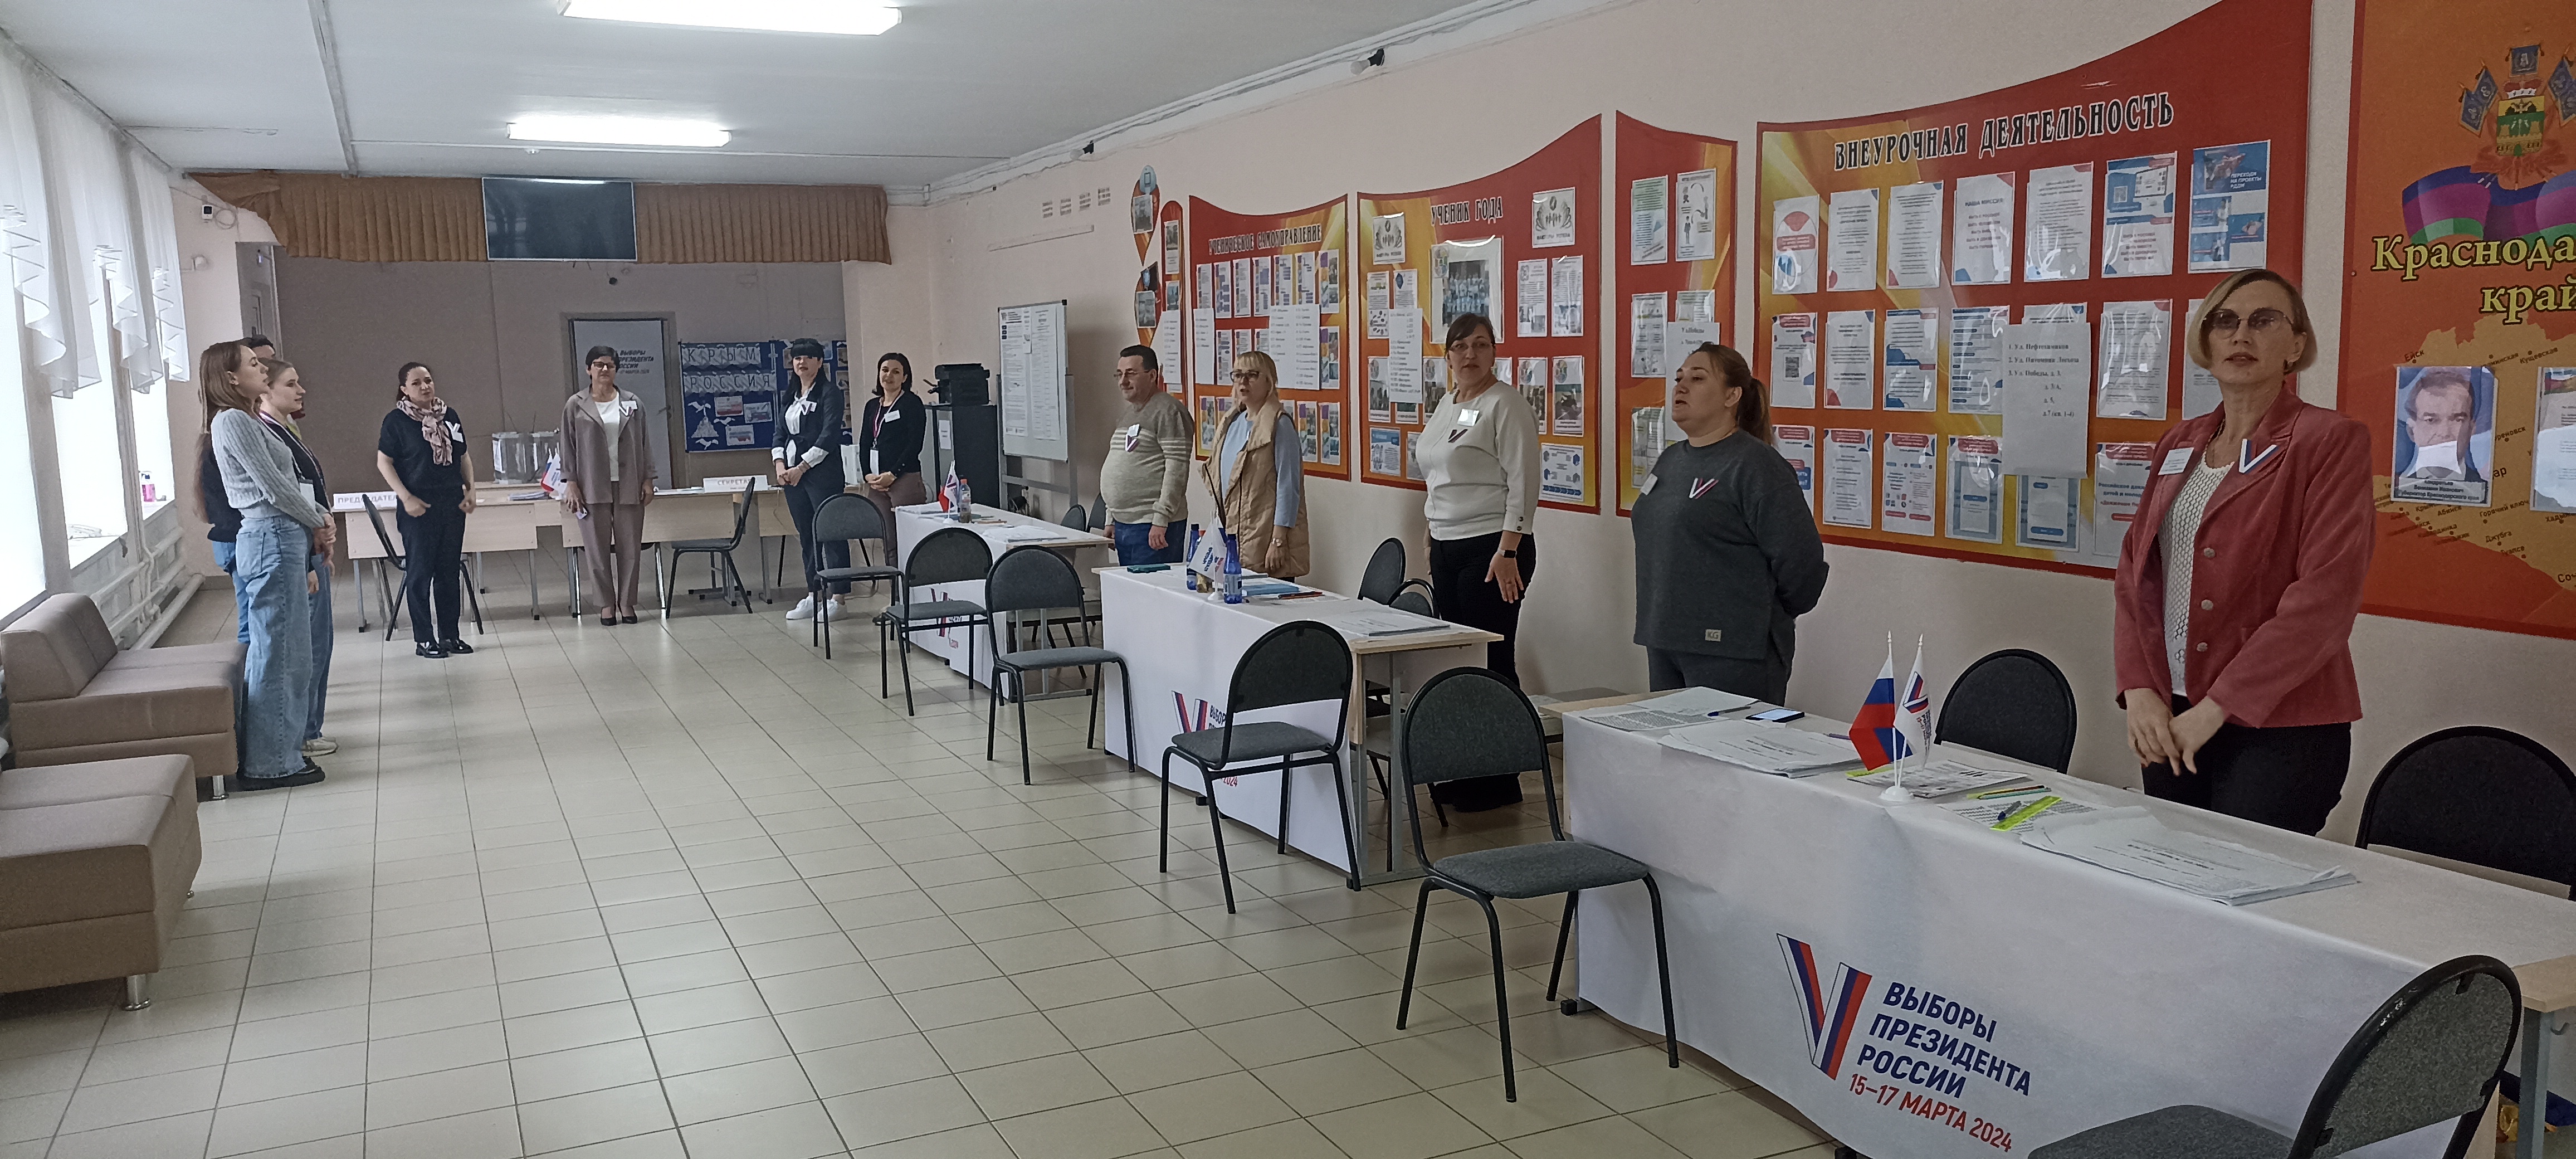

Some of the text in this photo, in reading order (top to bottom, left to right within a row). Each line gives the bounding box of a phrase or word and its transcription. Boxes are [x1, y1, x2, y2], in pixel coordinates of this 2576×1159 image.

[1834, 92, 2174, 171] ВНЕУРОЧНАЯ ДЕЯТЕЛЬНОСТЬ
[1431, 196, 1503, 227] УЧЕНИК ГОДА
[1208, 223, 1322, 255] УЧЕНИЧЕСКОЕ САМОУПРАВЛЕНИЕ
[2371, 234, 2576, 282] Краснода
[2480, 274, 2576, 325] край
[687, 348, 756, 361] КРЫМ
[690, 374, 770, 389] РОССИЯ
[338, 495, 397, 503] ПРЕДДАТЕЛ
[2558, 573, 2576, 583] Соч
[1209, 705, 1226, 726] ВЫБОР
[1223, 776, 1238, 787] 2024
[1882, 982, 1997, 1043] ВЫБОРЫ
[1869, 1013, 2031, 1096] ПРЕЗИДЕНТА
[1856, 1044, 1967, 1099] РОССИИ
[1899, 1091, 1968, 1131] МАРТА
[1969, 1117, 2012, 1153] 2024
